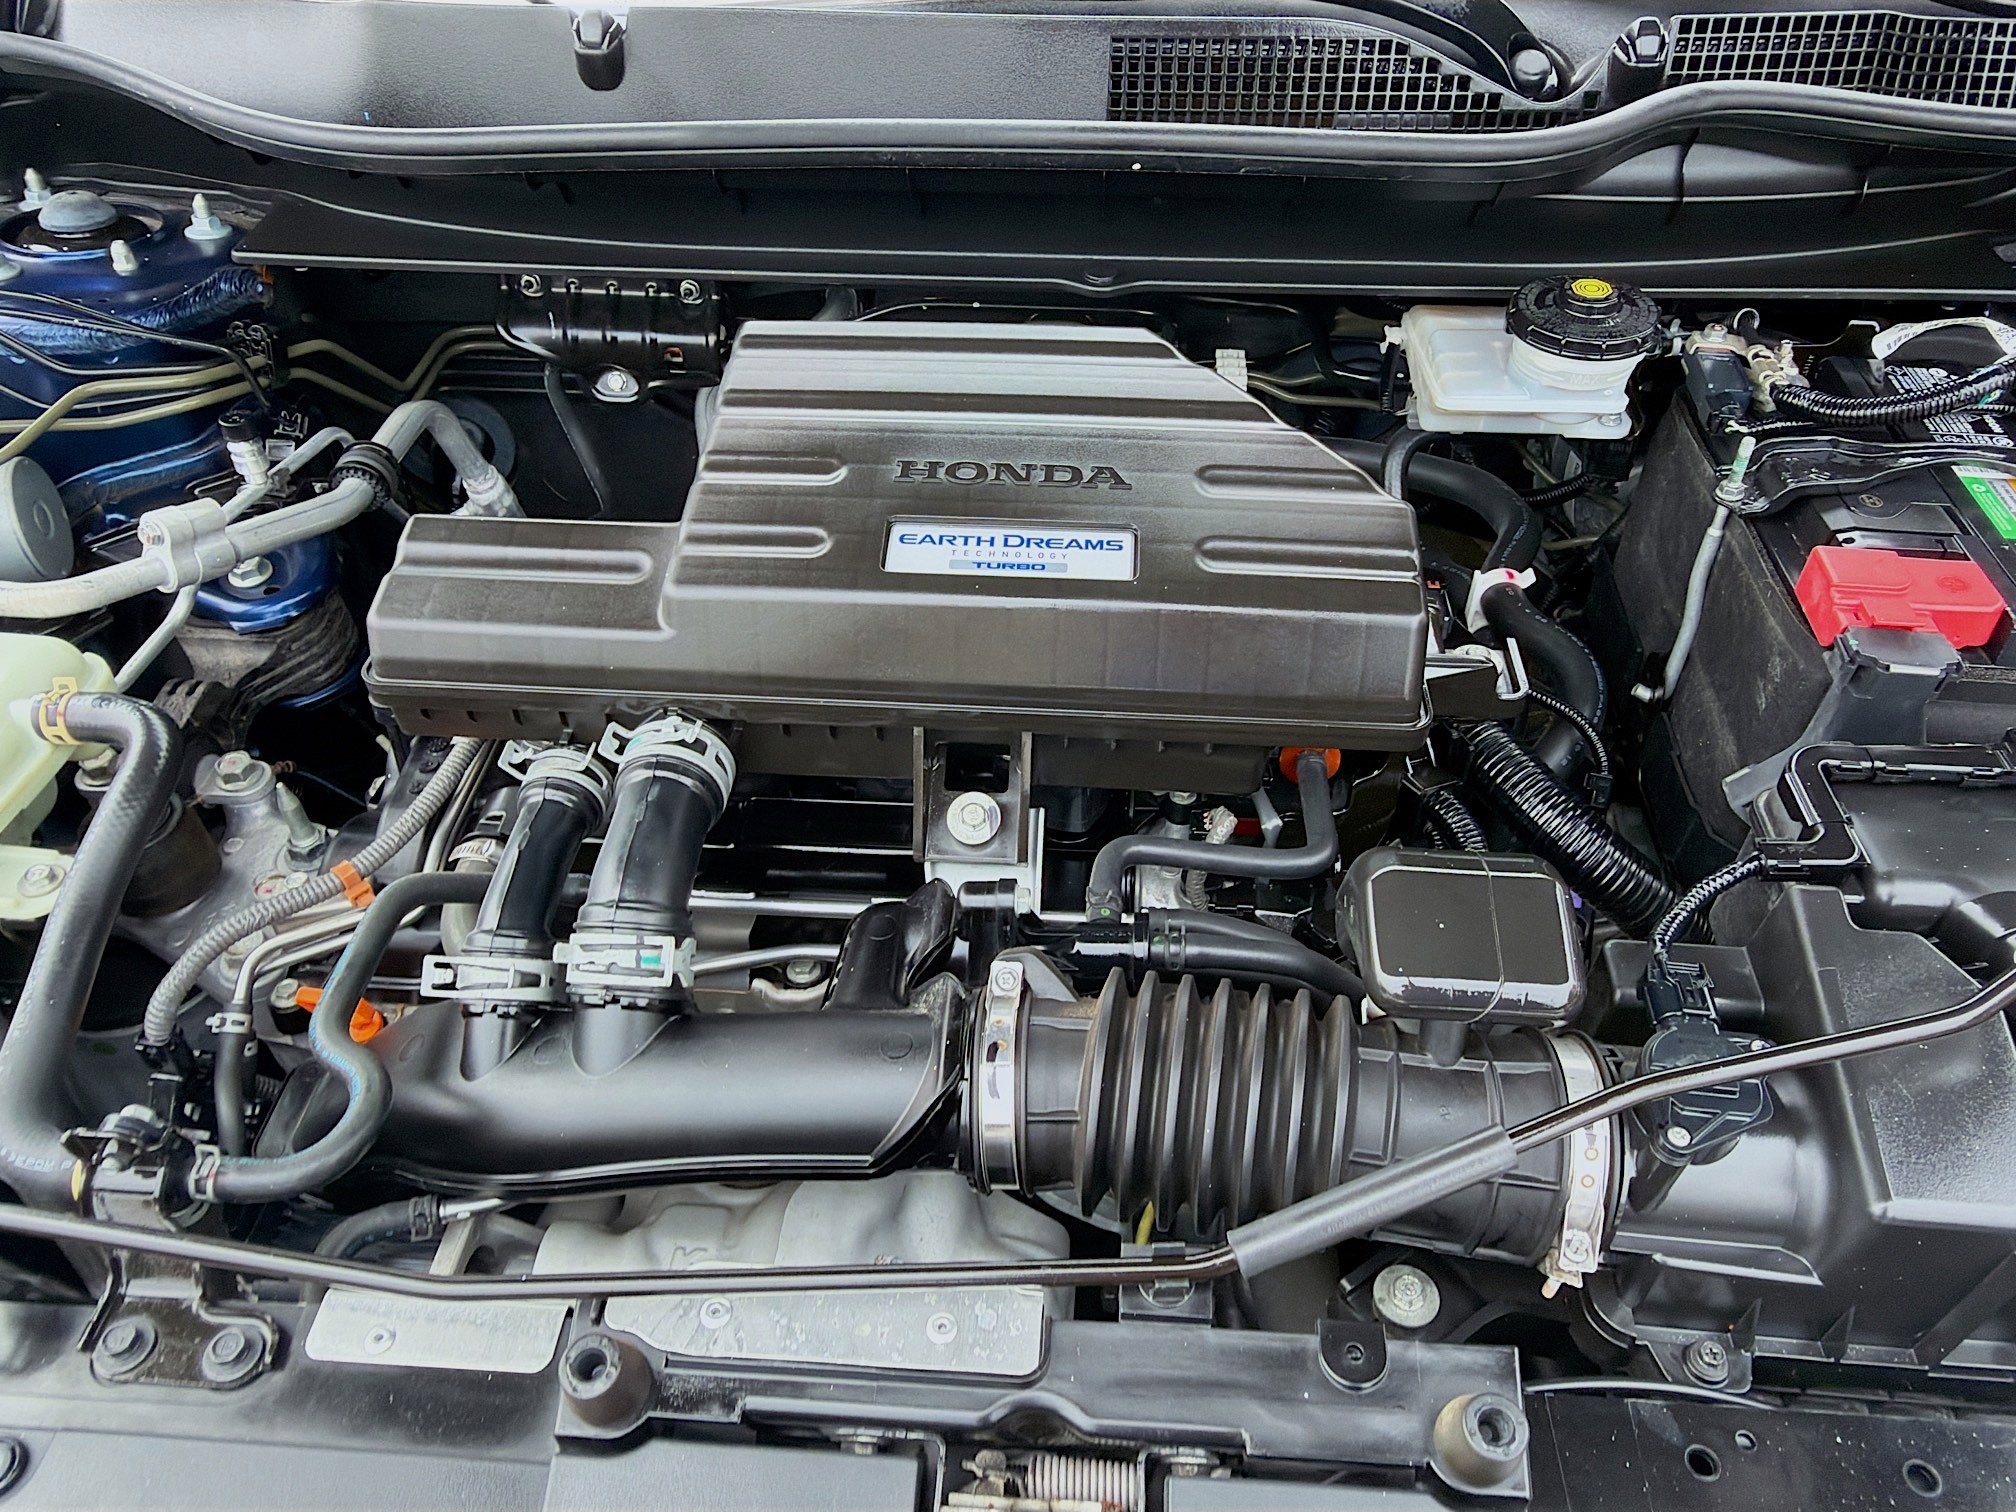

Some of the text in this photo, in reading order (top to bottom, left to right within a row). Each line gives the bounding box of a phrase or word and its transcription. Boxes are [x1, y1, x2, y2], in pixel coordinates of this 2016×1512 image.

[893, 459, 1133, 490] HONDA
[899, 533, 1124, 551] EARTH DREAMS
[951, 549, 1068, 560] TECHNOLOGY
[972, 561, 1046, 571] TURBO
